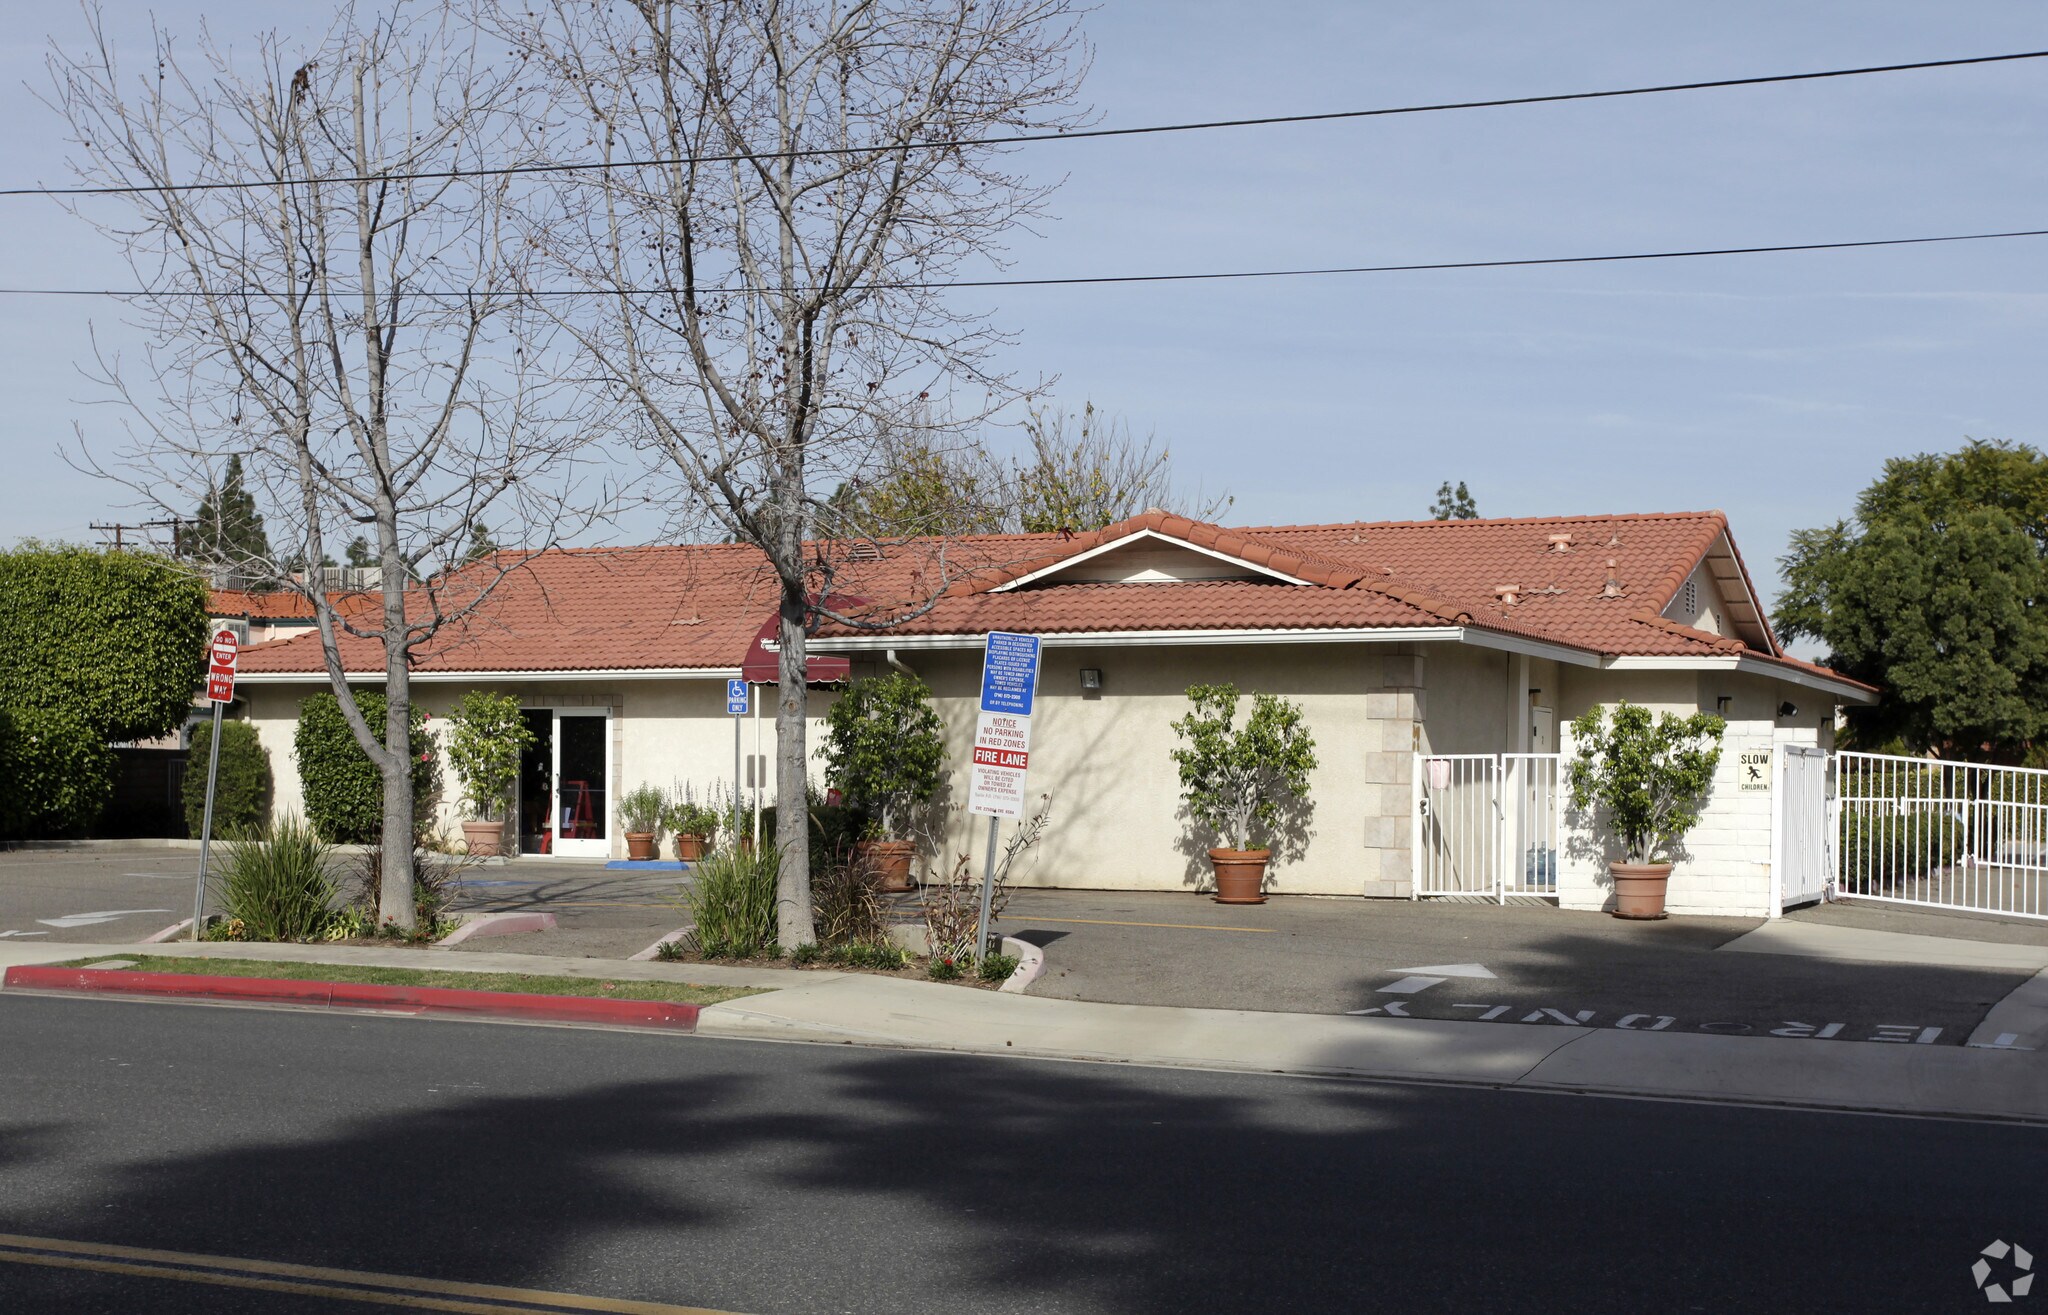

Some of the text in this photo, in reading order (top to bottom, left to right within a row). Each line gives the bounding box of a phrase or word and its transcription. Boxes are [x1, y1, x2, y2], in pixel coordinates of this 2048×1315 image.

[211, 672, 233, 683] WRONG
[214, 684, 227, 694] WAY
[993, 718, 1016, 727] NOTICE
[995, 728, 1024, 738] PARKING
[1004, 739, 1025, 748] ZONES
[975, 750, 1026, 766] FIRE LANE
[1741, 755, 1768, 764] SLOW
[1346, 1001, 1676, 1030] ONLY
